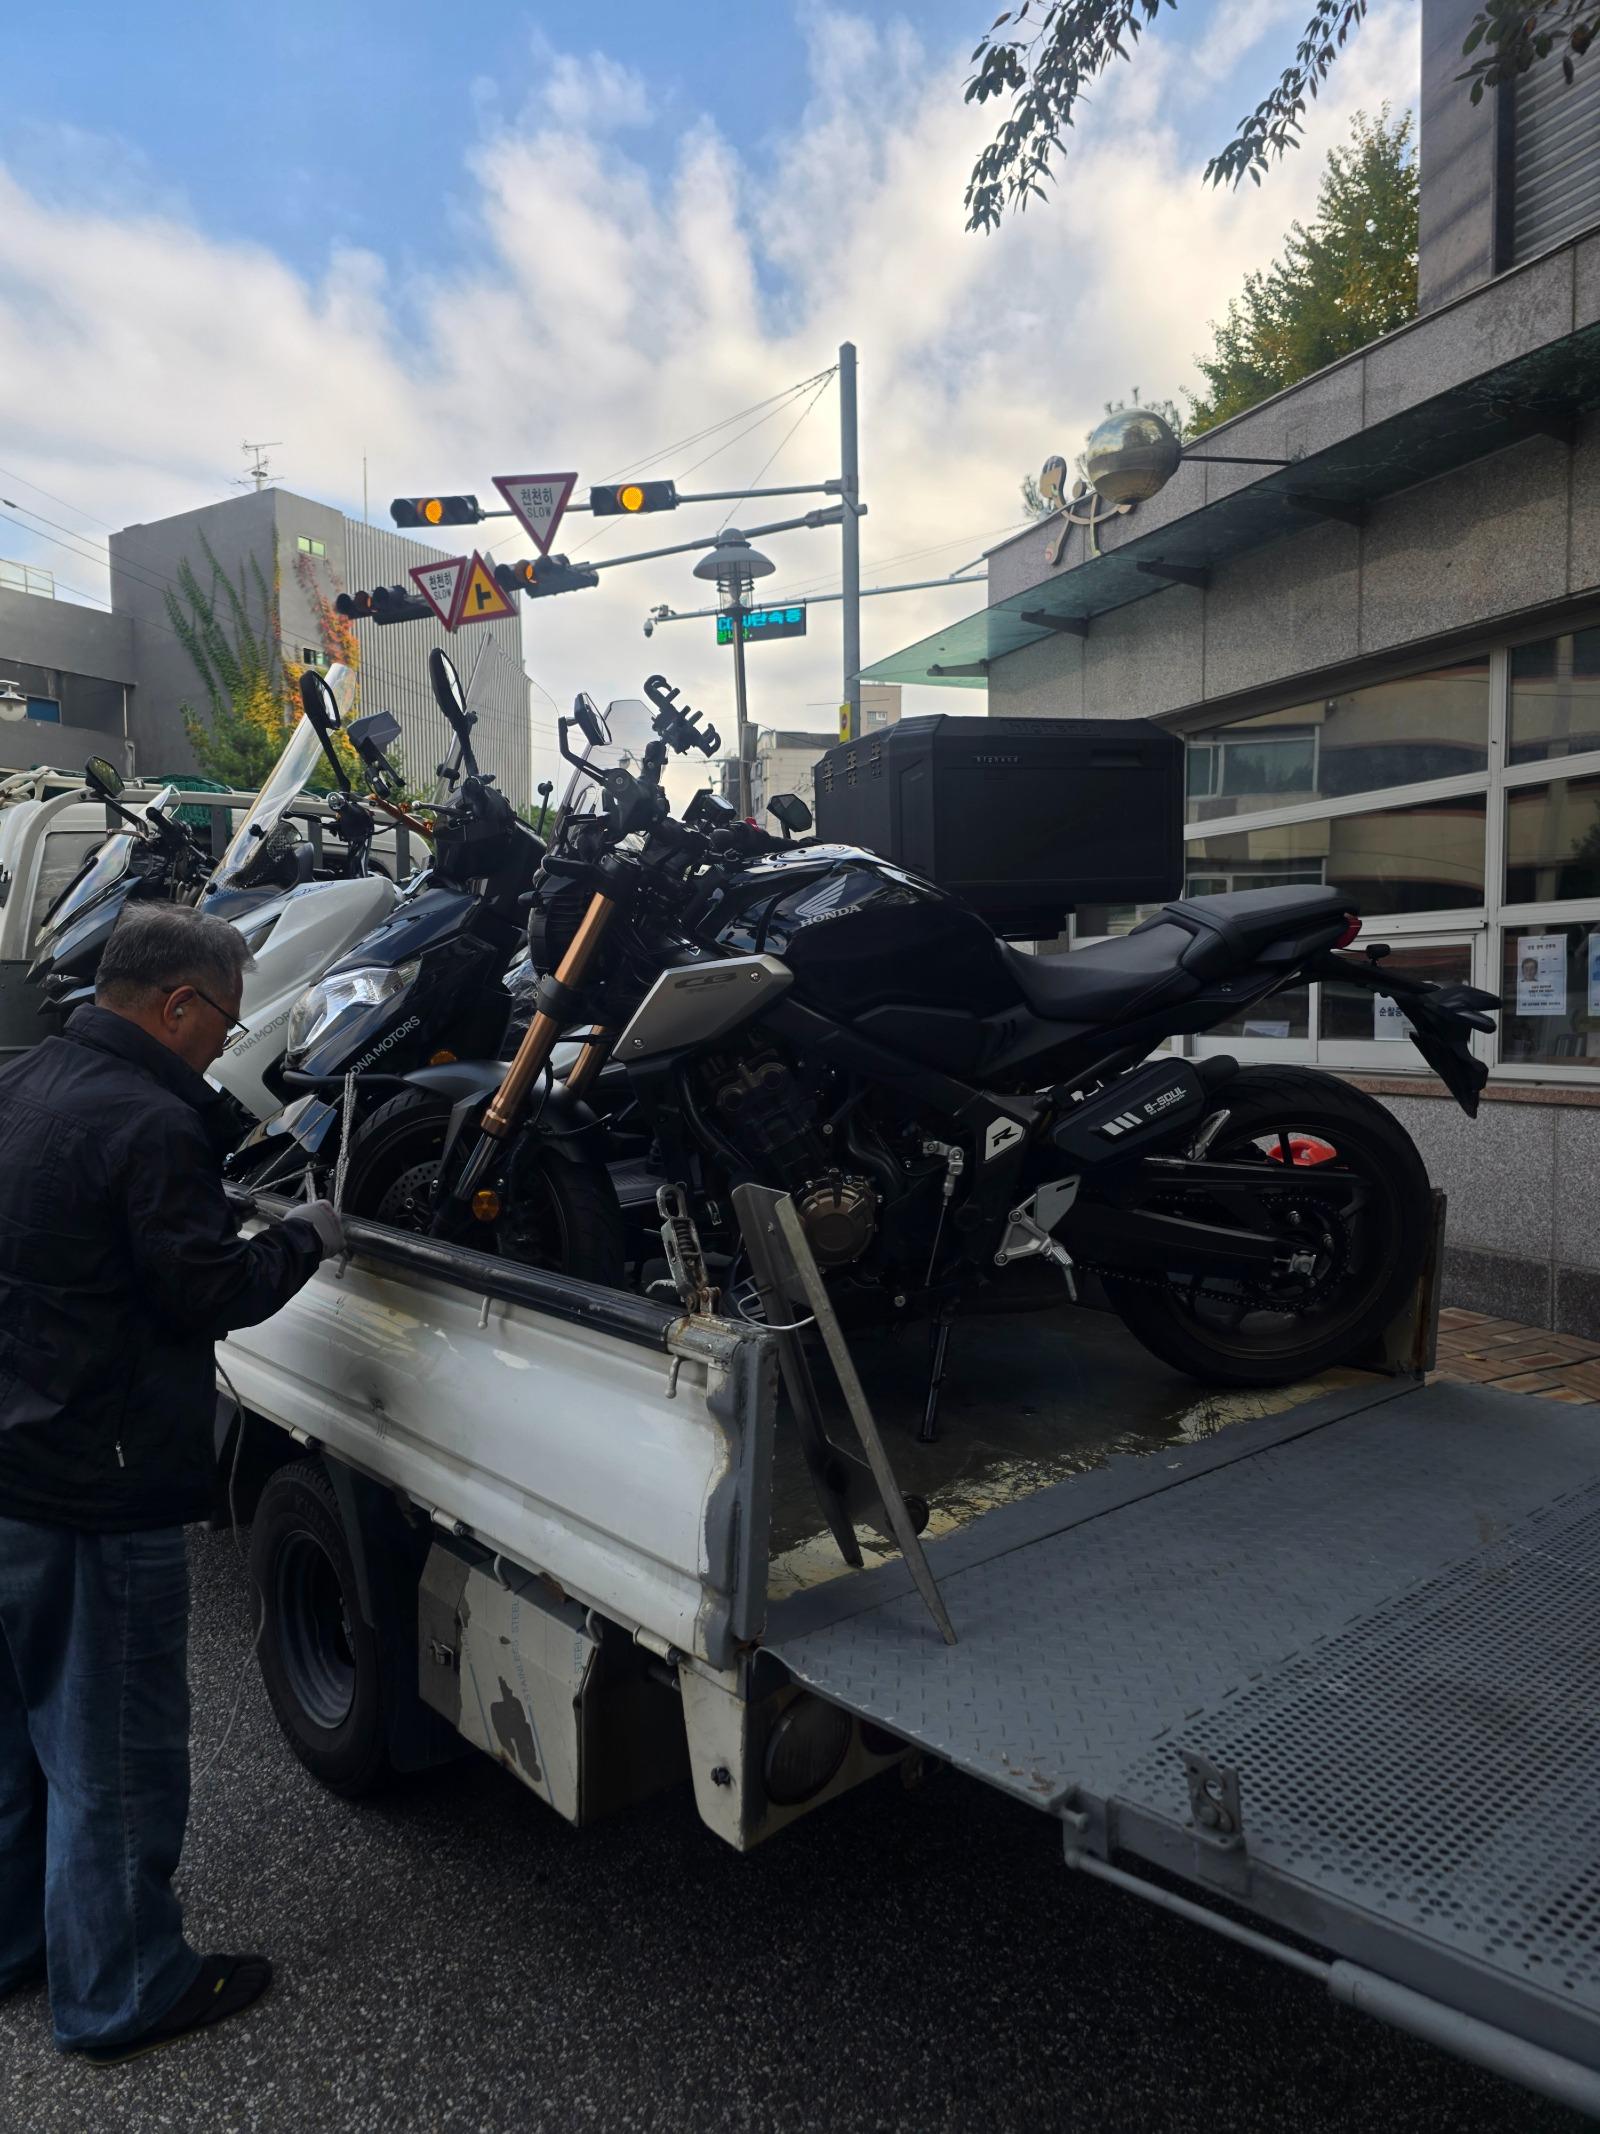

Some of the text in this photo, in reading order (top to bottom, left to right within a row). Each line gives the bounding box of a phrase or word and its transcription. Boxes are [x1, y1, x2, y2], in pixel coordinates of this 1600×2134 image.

[520, 488, 553, 506] 천천히
[526, 506, 551, 518] SLOW
[429, 571, 453, 590] 천천히
[433, 589, 451, 600] SLOW
[800, 904, 862, 928] HONDA
[233, 1007, 292, 1057] DNA MOTOR
[350, 1015, 421, 1075] DNA MOTORS
